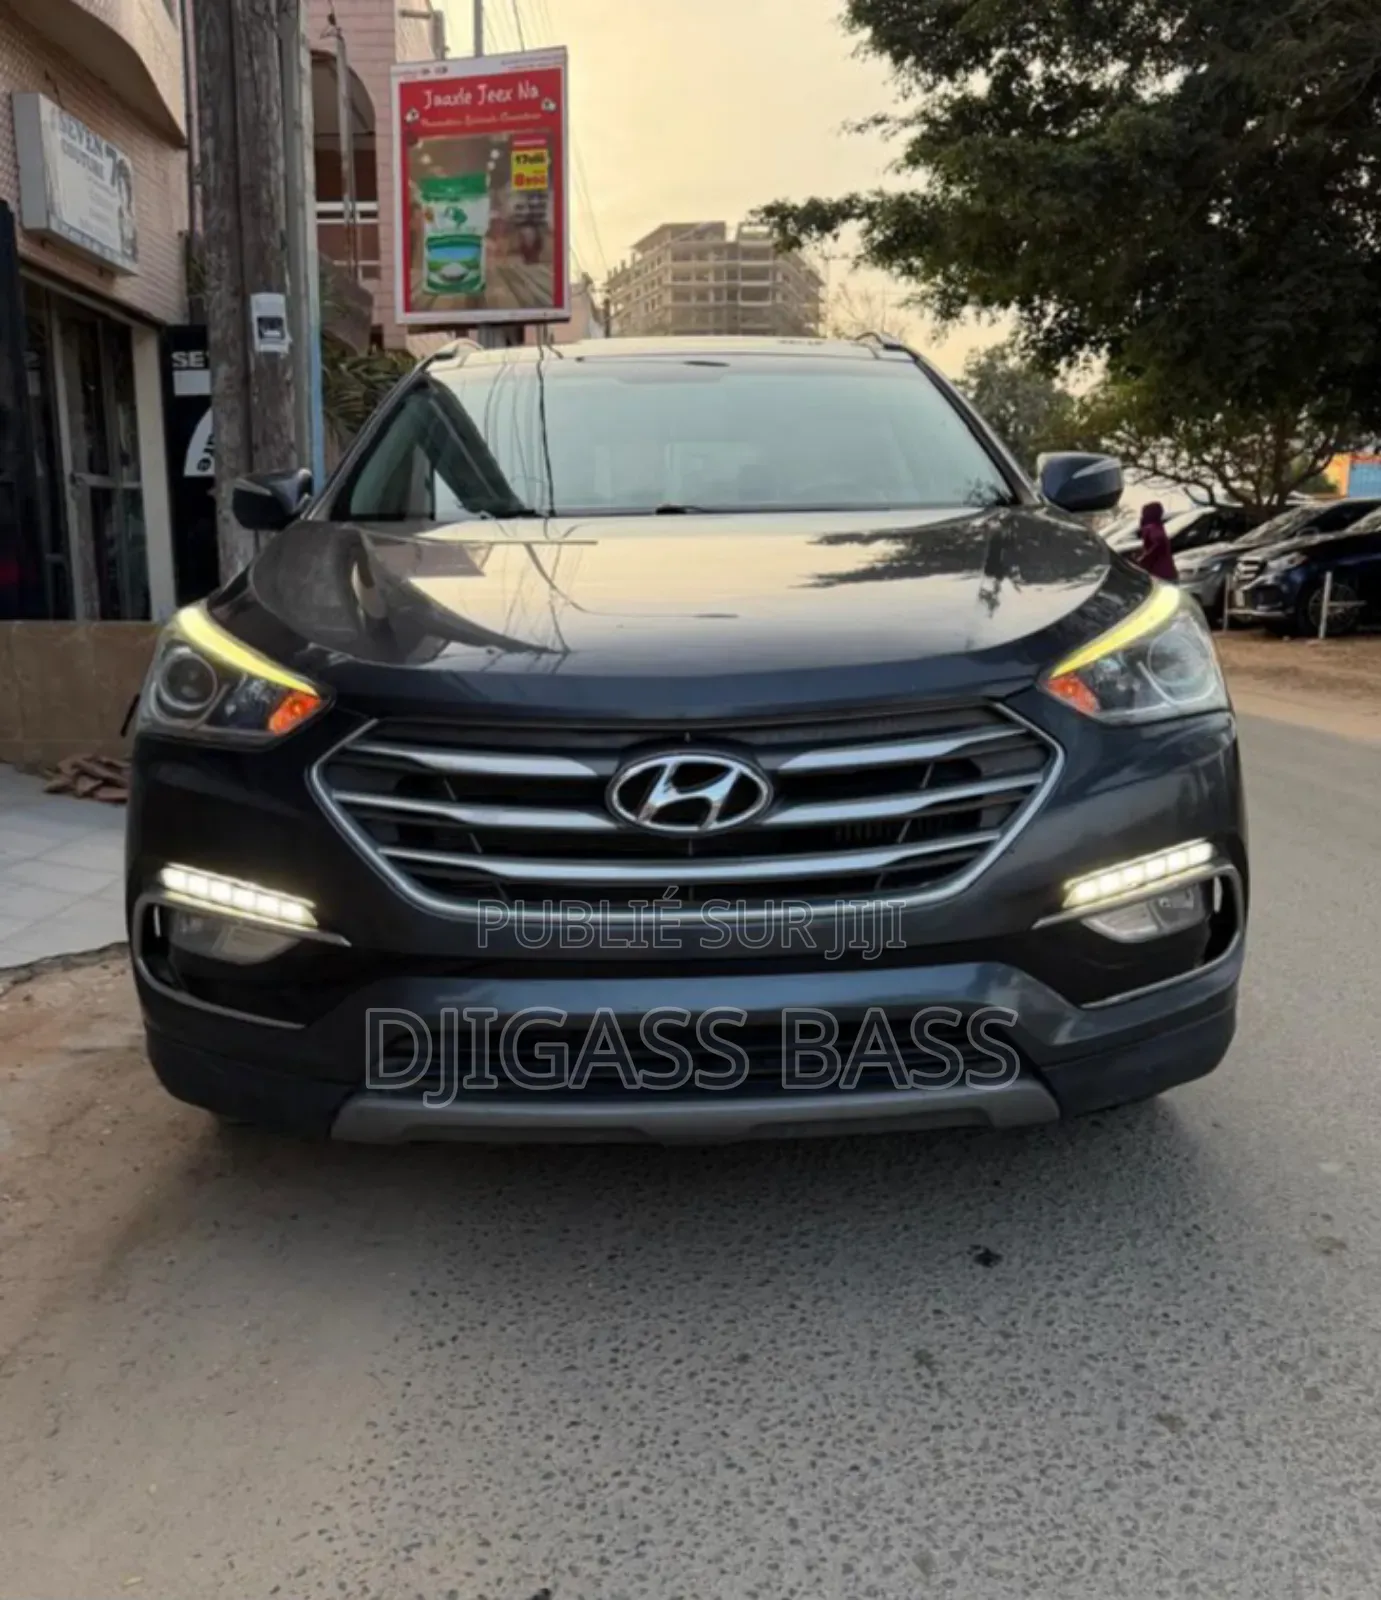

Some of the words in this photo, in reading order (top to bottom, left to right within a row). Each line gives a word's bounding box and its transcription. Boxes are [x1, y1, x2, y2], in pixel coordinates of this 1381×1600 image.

[518, 80, 540, 99] Na
[59, 111, 103, 157] SEVEN
[105, 144, 118, 187] 7
[171, 350, 210, 368] SE
